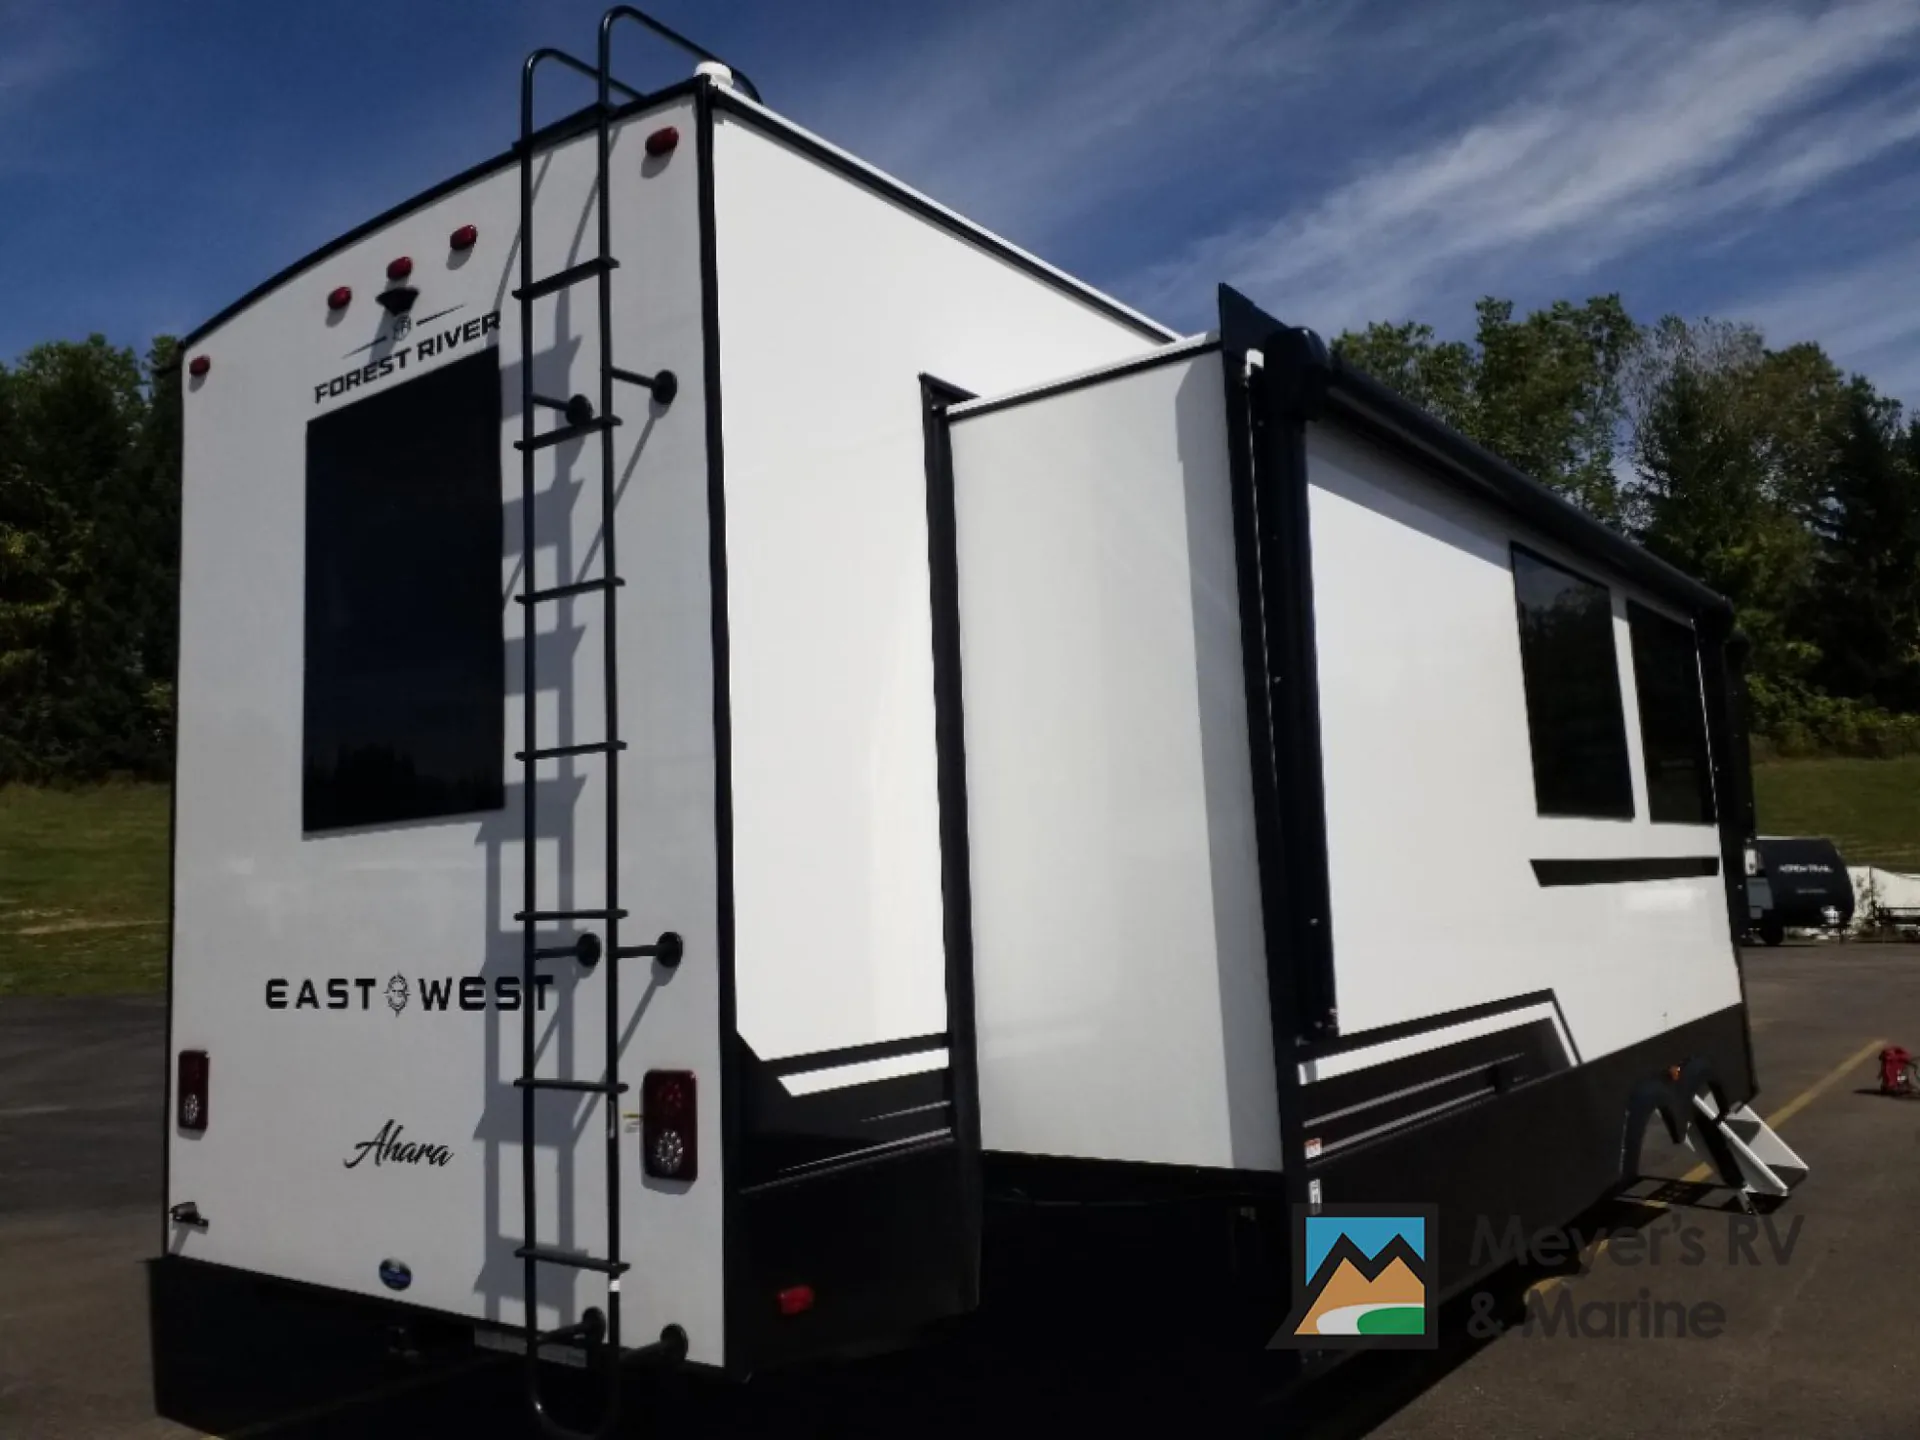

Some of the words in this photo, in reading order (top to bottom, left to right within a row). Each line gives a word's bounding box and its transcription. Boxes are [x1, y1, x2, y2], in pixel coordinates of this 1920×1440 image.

[314, 347, 412, 404] FOREST
[417, 310, 501, 361] RIVER
[265, 977, 377, 1010] EAST
[417, 974, 554, 1012] WEST
[343, 1118, 454, 1169] Ahara
